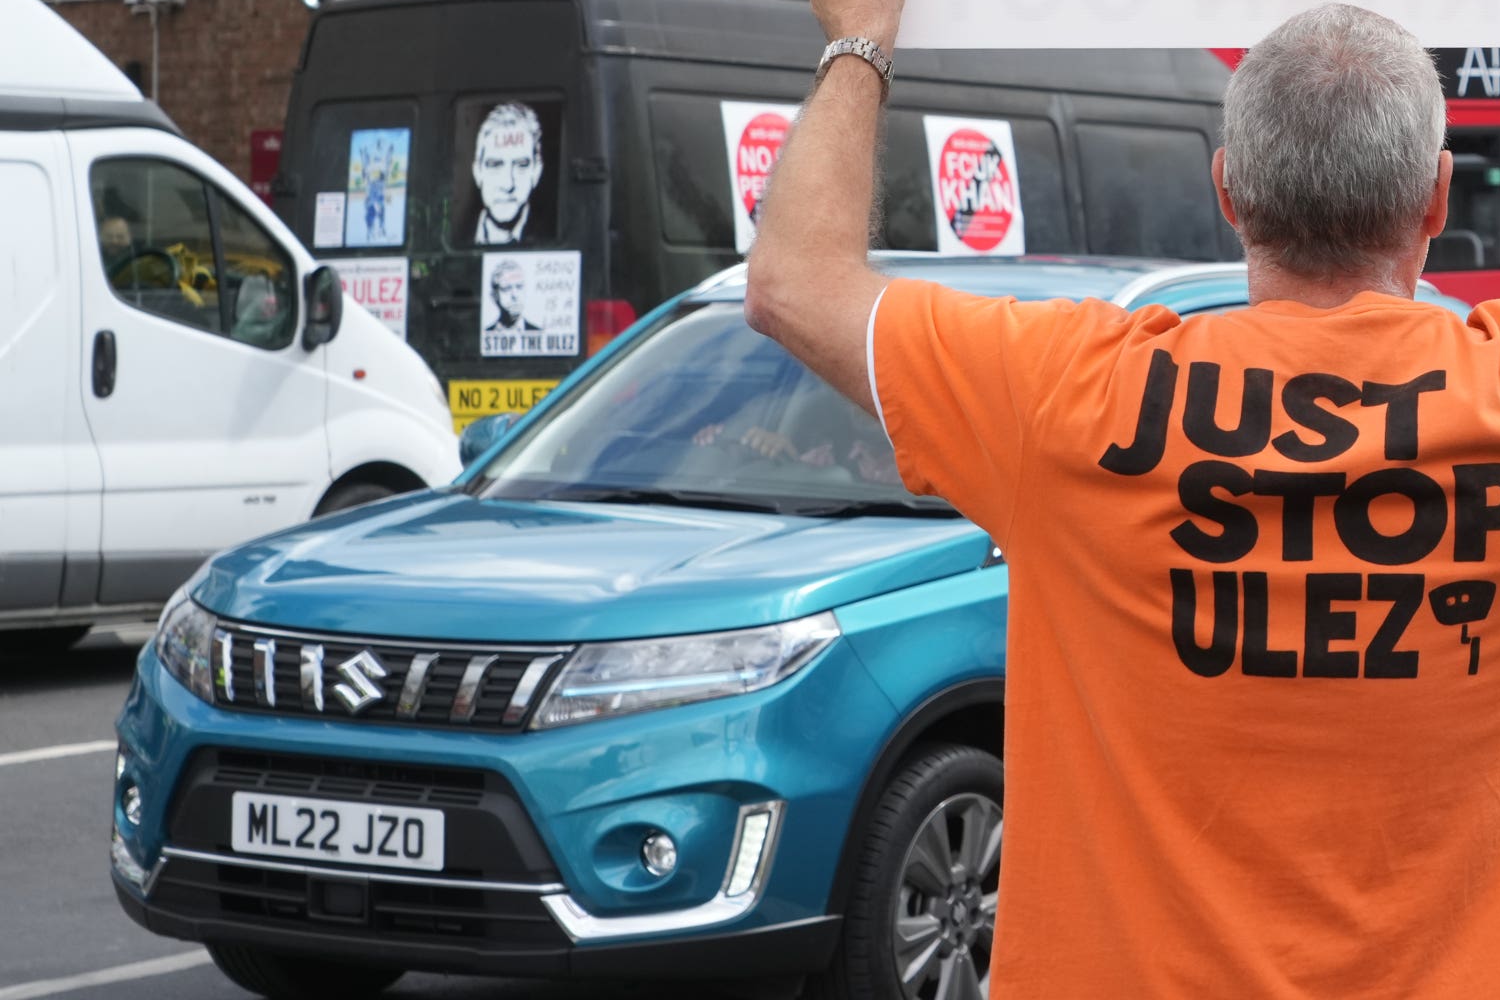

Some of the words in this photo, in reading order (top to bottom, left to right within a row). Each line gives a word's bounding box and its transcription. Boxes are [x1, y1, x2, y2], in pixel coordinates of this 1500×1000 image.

[740, 145, 773, 174] NO
[945, 151, 1003, 182] FCUK
[940, 178, 1012, 214] KHAN
[352, 276, 404, 306] ULEZ
[485, 335, 516, 351] STOP
[521, 335, 541, 351] THE
[547, 334, 575, 350] ULEZ
[459, 387, 481, 409] NO
[490, 387, 500, 409] 2
[1098, 348, 1447, 477] JUST
[1169, 567, 1426, 679] ULEZ
[248, 802, 340, 851] ML22
[353, 813, 424, 860] JZO
